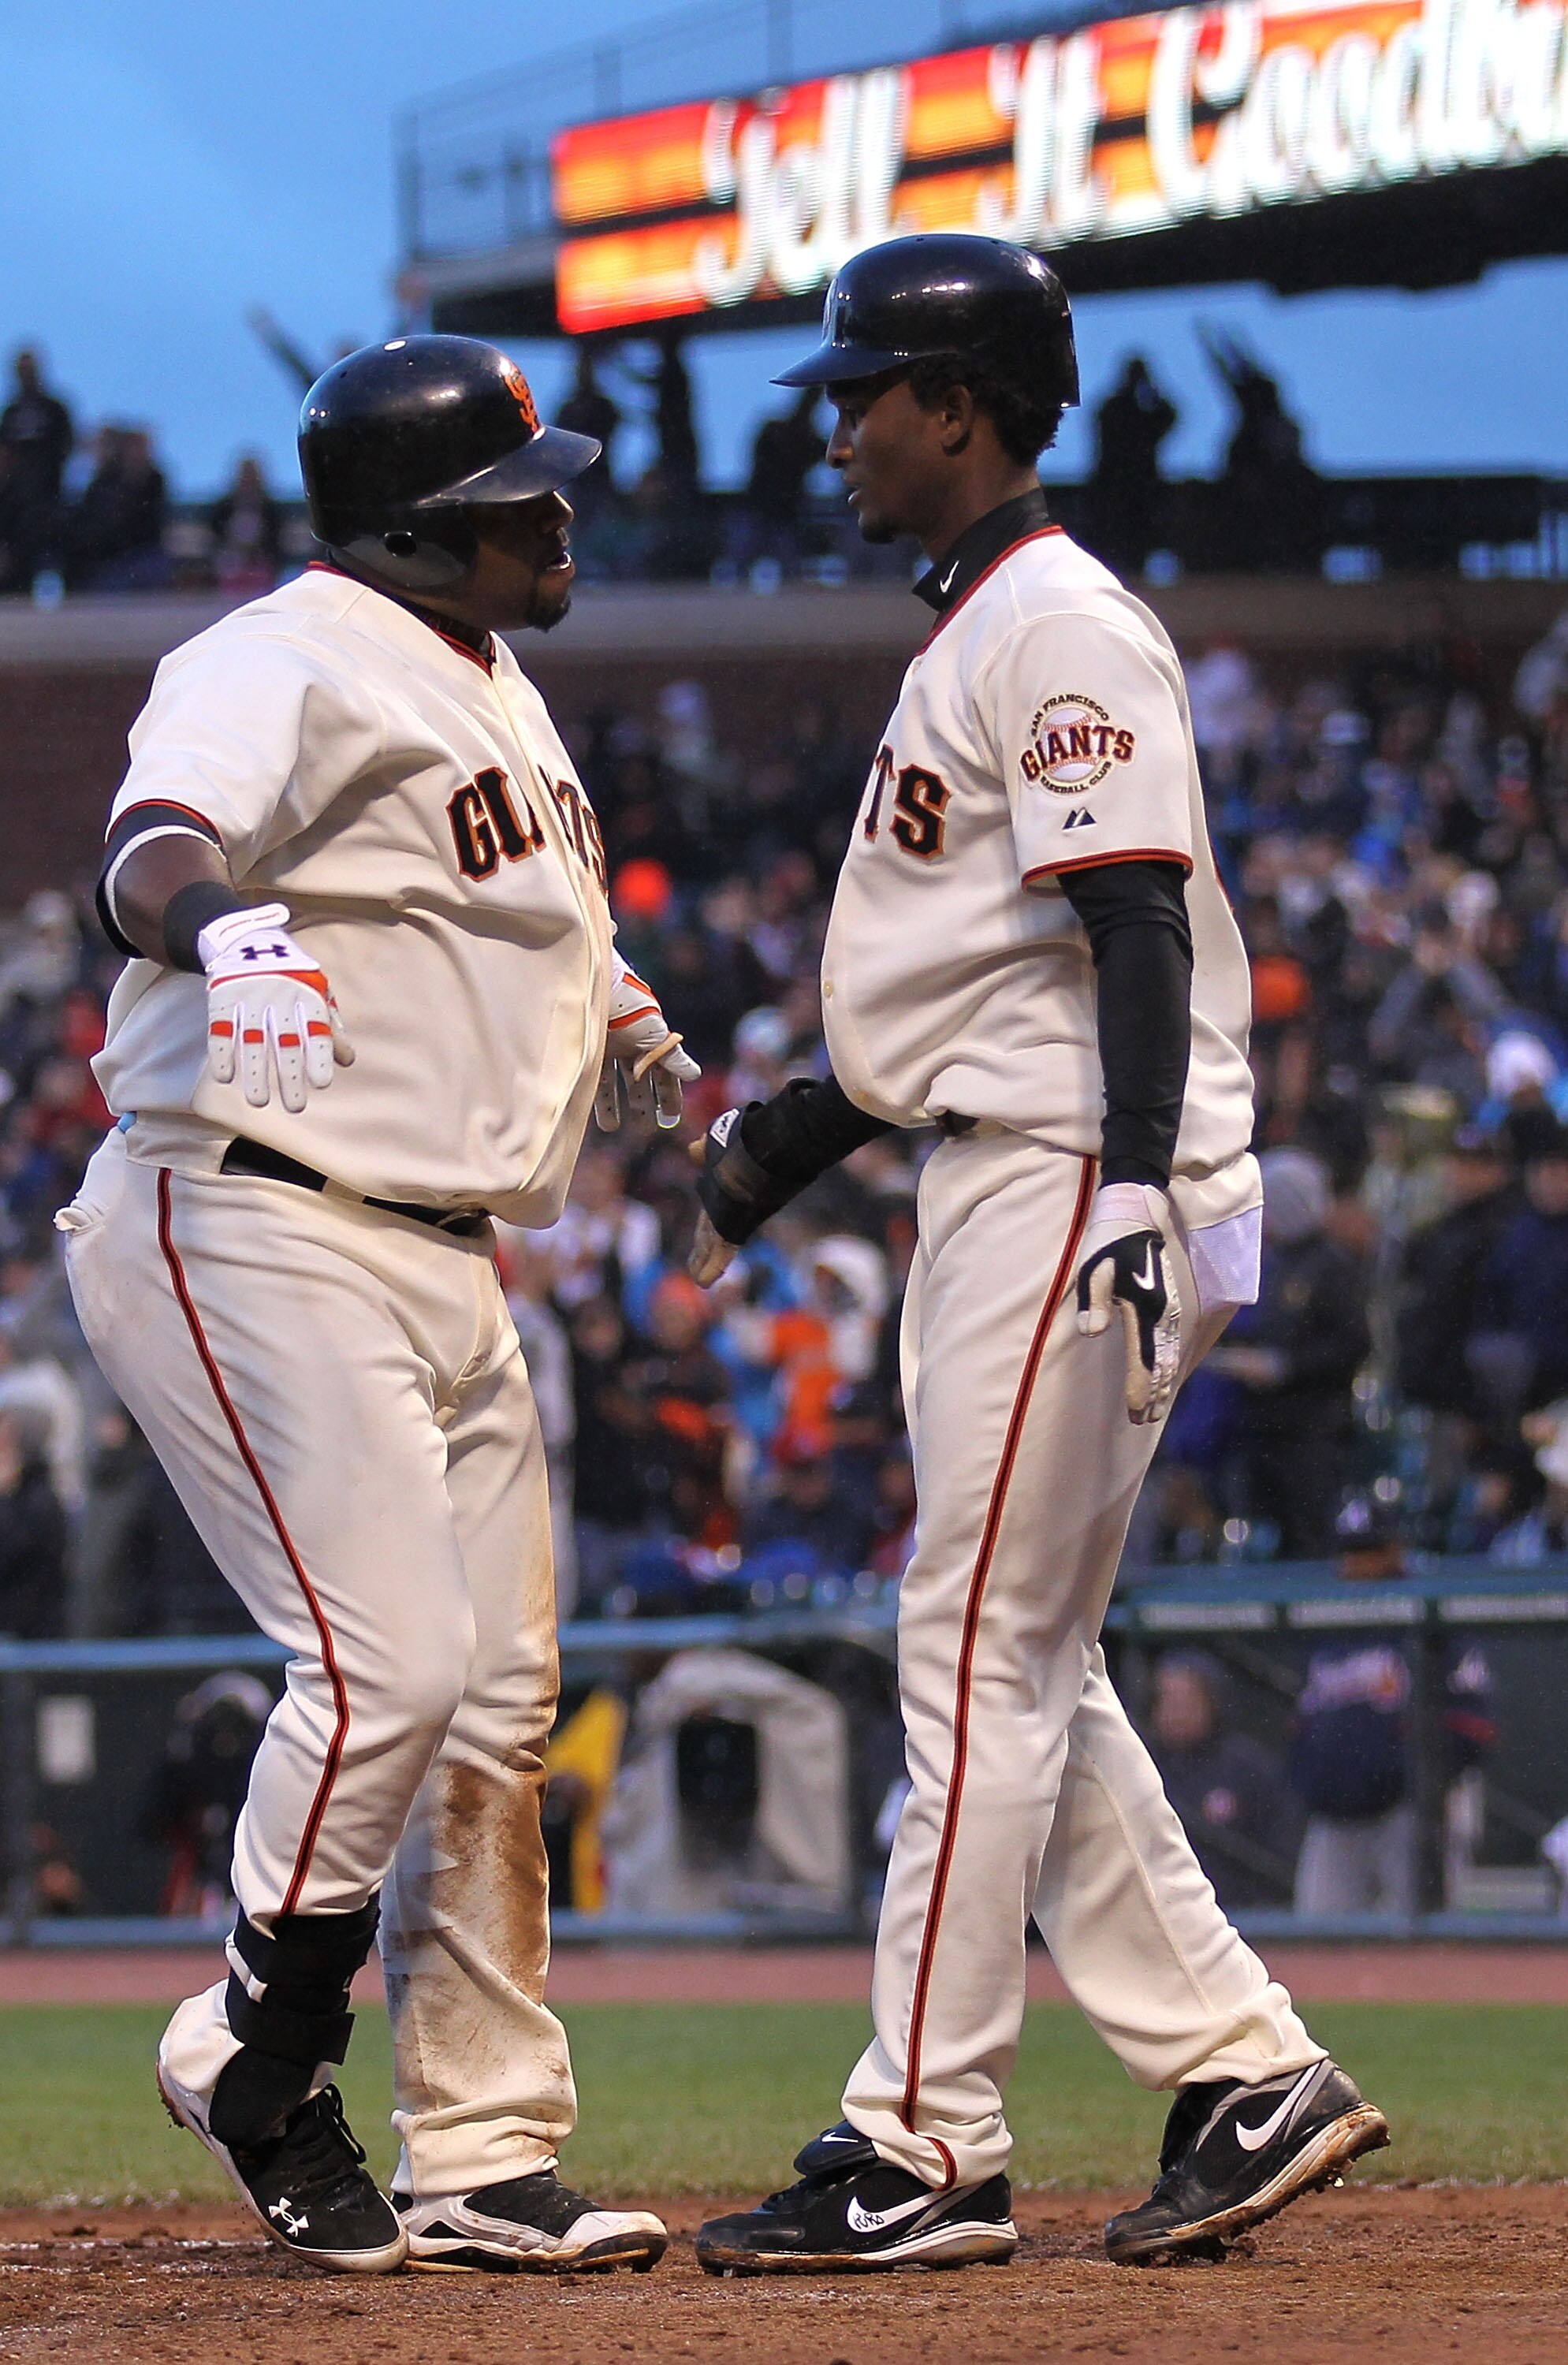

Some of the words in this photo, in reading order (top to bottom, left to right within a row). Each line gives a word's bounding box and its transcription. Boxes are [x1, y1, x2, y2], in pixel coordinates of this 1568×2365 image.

[975, 33, 1115, 251] It
[1031, 711, 1044, 736] SAN
[1043, 694, 1109, 721] FRANCISCO
[1020, 725, 1135, 782] GIANTS
[1041, 776, 1089, 794] BASEBALL
[1089, 761, 1112, 784] CLUB
